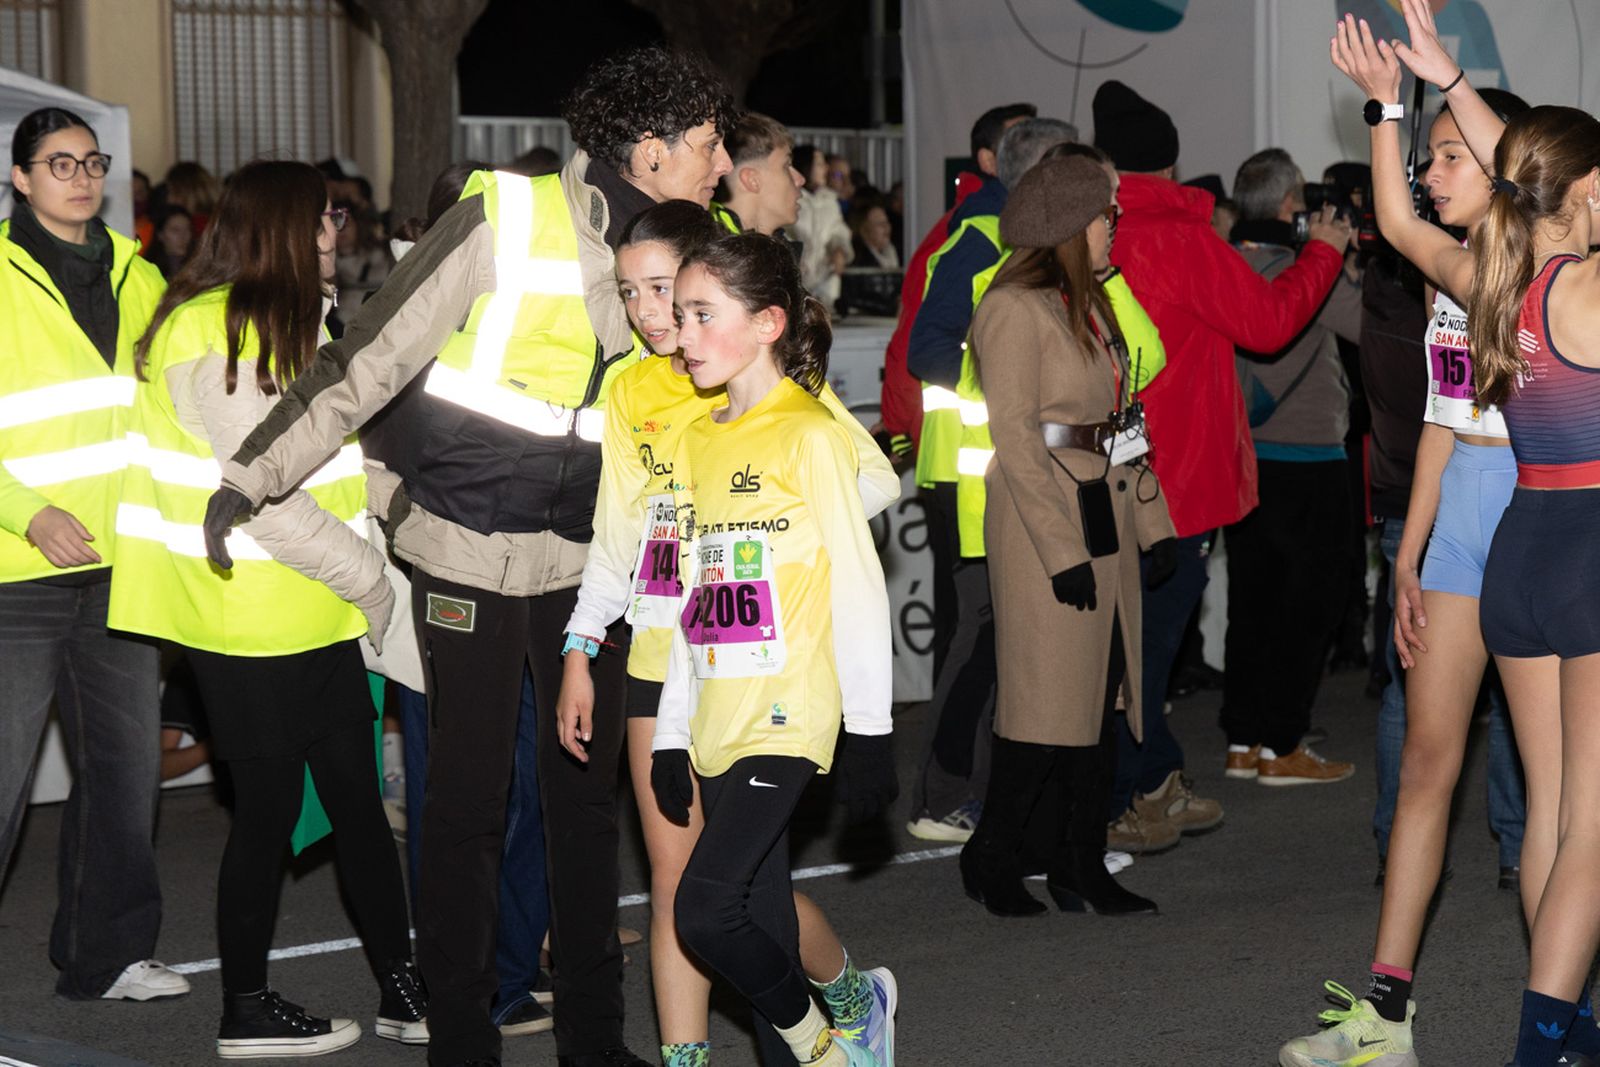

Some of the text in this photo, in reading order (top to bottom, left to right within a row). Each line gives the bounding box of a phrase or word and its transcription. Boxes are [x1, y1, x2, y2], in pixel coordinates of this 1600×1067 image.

[1447, 318, 1468, 332] NOC
[1435, 331, 1472, 347] SAN AN
[1438, 348, 1474, 387] 15
[730, 464, 761, 493] als
[652, 525, 669, 539] SAN
[652, 543, 681, 585] 14
[713, 549, 724, 563] DE
